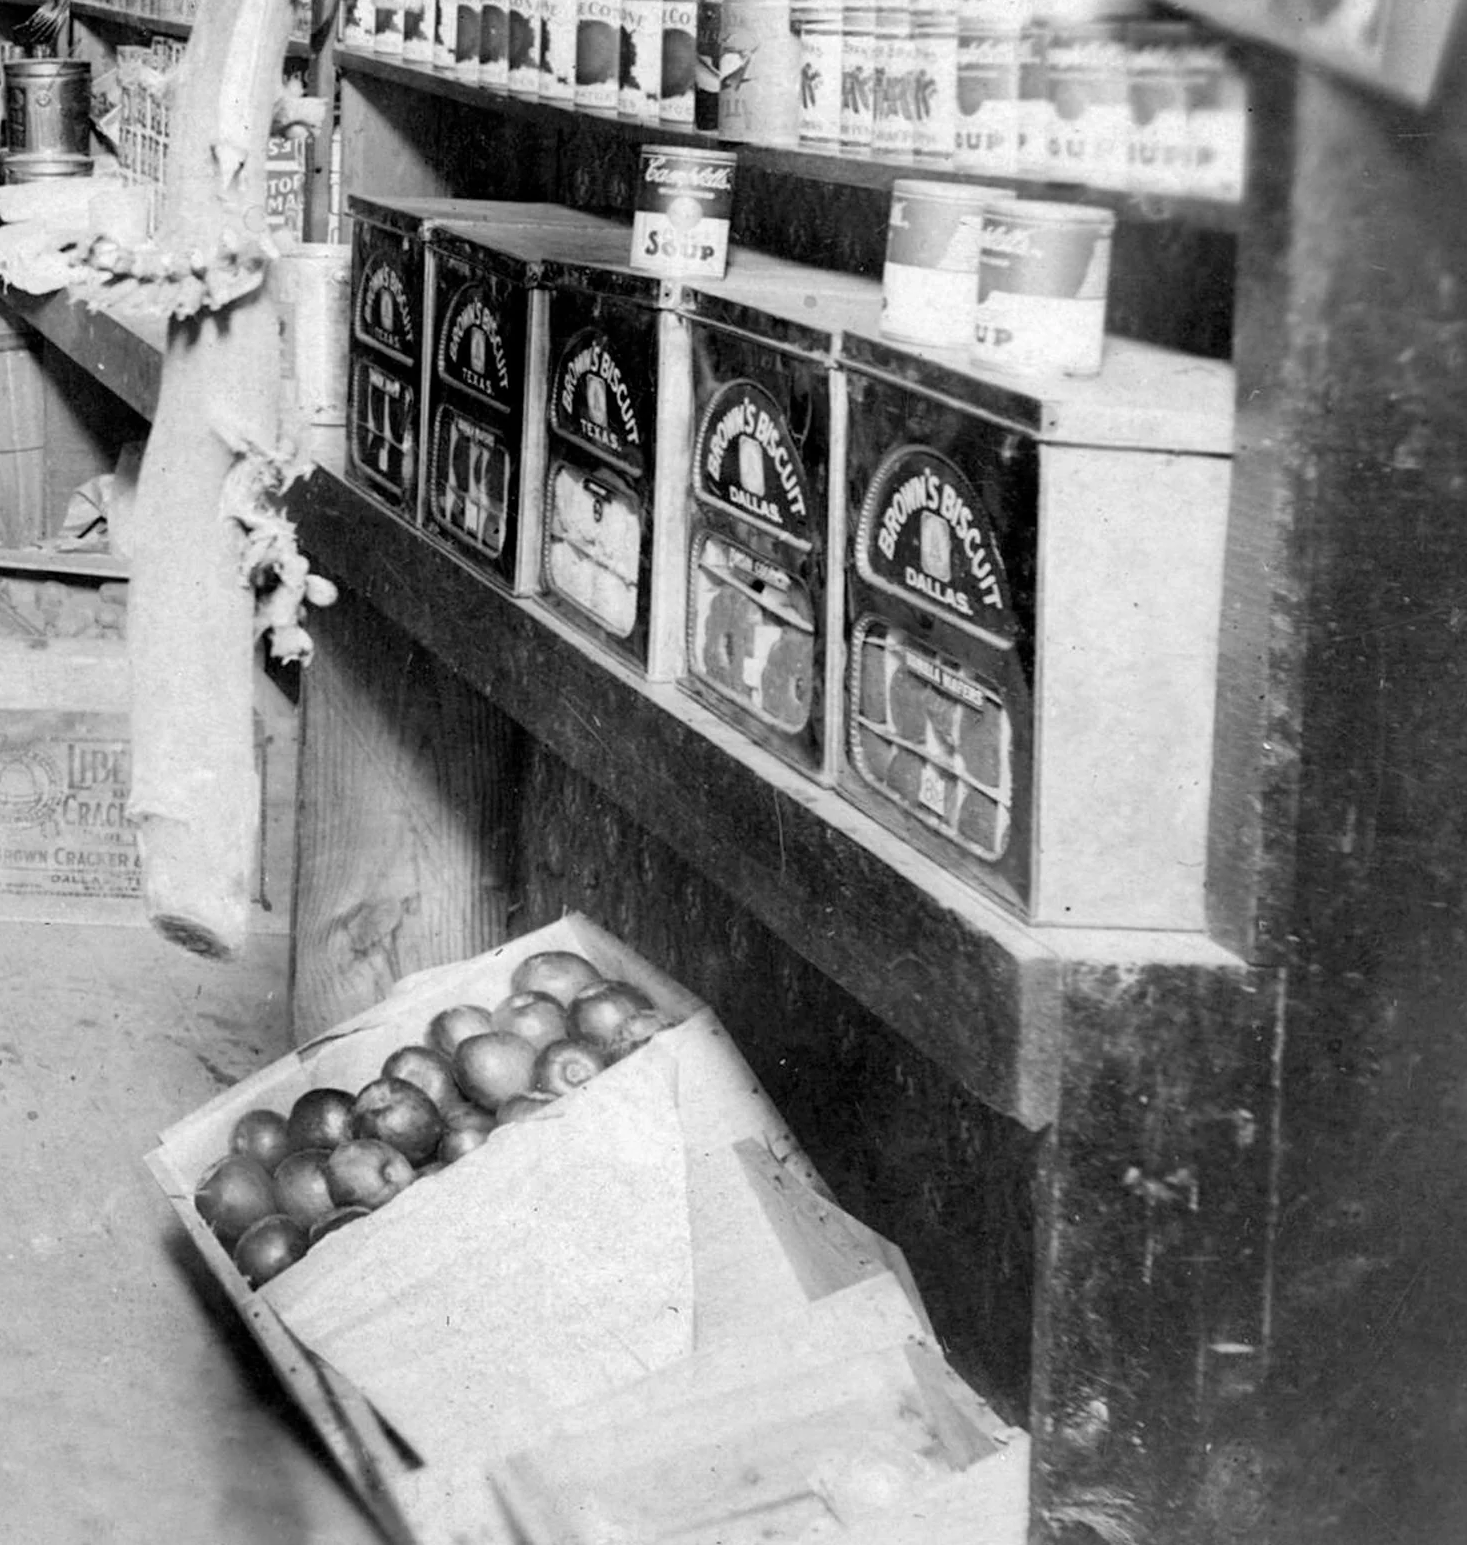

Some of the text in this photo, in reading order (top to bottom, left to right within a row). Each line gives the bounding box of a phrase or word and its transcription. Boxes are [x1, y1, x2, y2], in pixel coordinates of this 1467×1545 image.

[450, 297, 481, 362] BROWN'S
[482, 306, 509, 389] BISCUIT
[562, 340, 640, 444] BROWN'S BISCUIT
[707, 397, 806, 516] BROWN'S BISCUIT
[878, 467, 1003, 609] BROWN'S BISCUIT
[54, 847, 129, 867] CRACKER
